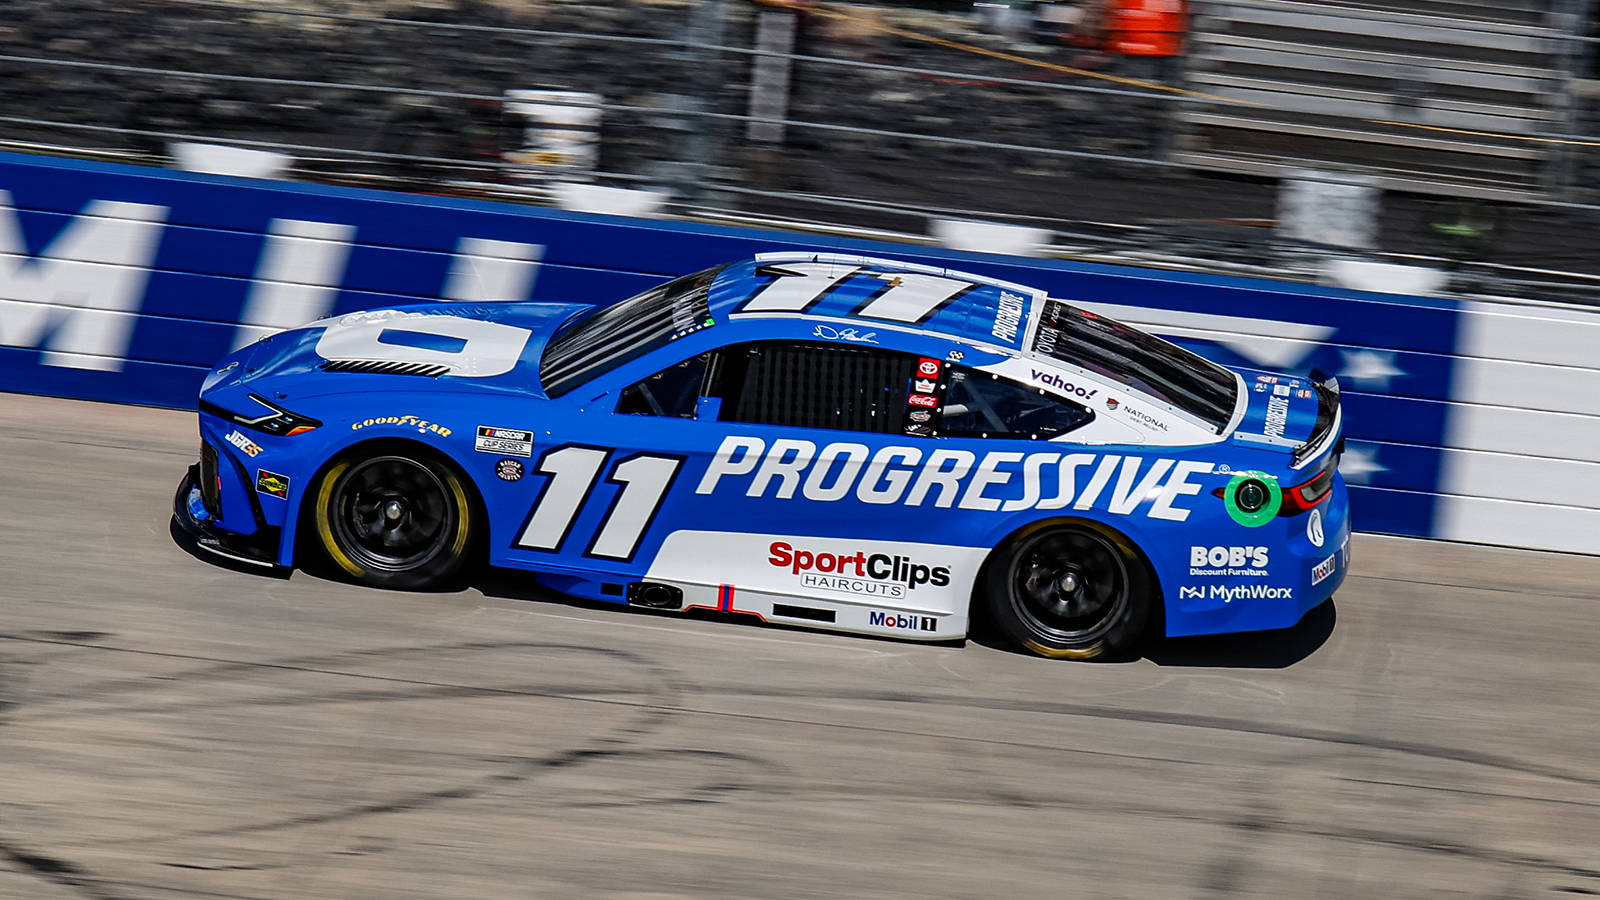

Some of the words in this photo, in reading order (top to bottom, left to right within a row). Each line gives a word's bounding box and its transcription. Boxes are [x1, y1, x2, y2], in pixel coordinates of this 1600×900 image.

[736, 261, 980, 324] 11
[991, 291, 1024, 344] PROGRESSIVE
[1031, 369, 1098, 400] yahoo!
[352, 415, 452, 438] GOODYEAR
[1124, 406, 1169, 432] NATIONAL
[483, 439, 498, 448] CUP
[498, 441, 525, 451] SERIES
[494, 430, 526, 441] NASCAR
[695, 435, 1216, 522] PROGRESSIVE
[514, 444, 685, 561] 11
[1190, 546, 1269, 567] BOB'S
[1189, 568, 1227, 576] Discount
[804, 575, 902, 597] HAIRCUTS
[1209, 585, 1293, 603] MythWorx
[869, 611, 918, 630] Mobil
